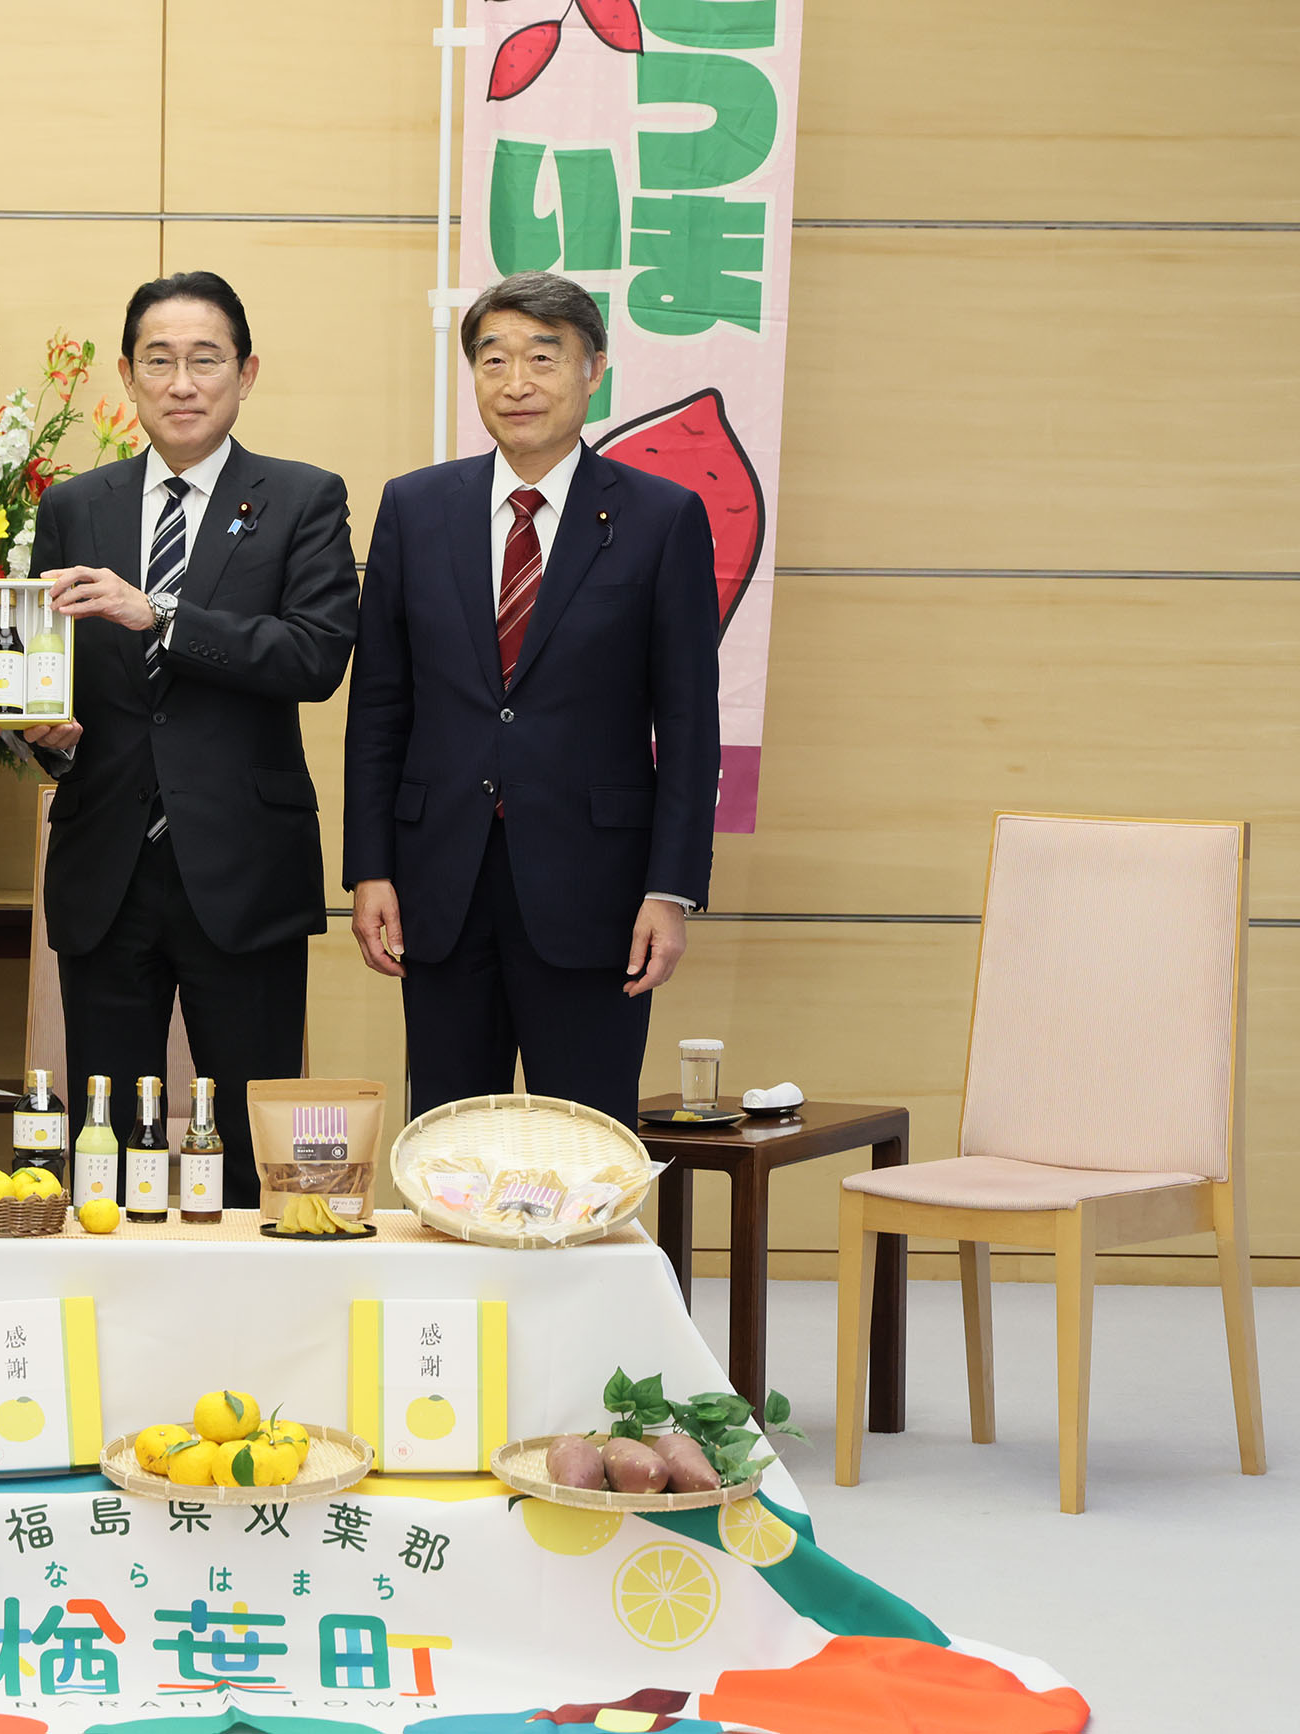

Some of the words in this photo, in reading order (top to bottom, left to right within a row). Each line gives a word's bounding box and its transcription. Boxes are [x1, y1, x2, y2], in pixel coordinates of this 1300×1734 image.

[4, 1325, 28, 1380] 感謝
[419, 1322, 442, 1378] 感謝
[5, 1496, 451, 1574] 福島県双葉郡
[44, 1560, 396, 1601] ならはまち
[284, 1698, 438, 1710] TOWN
